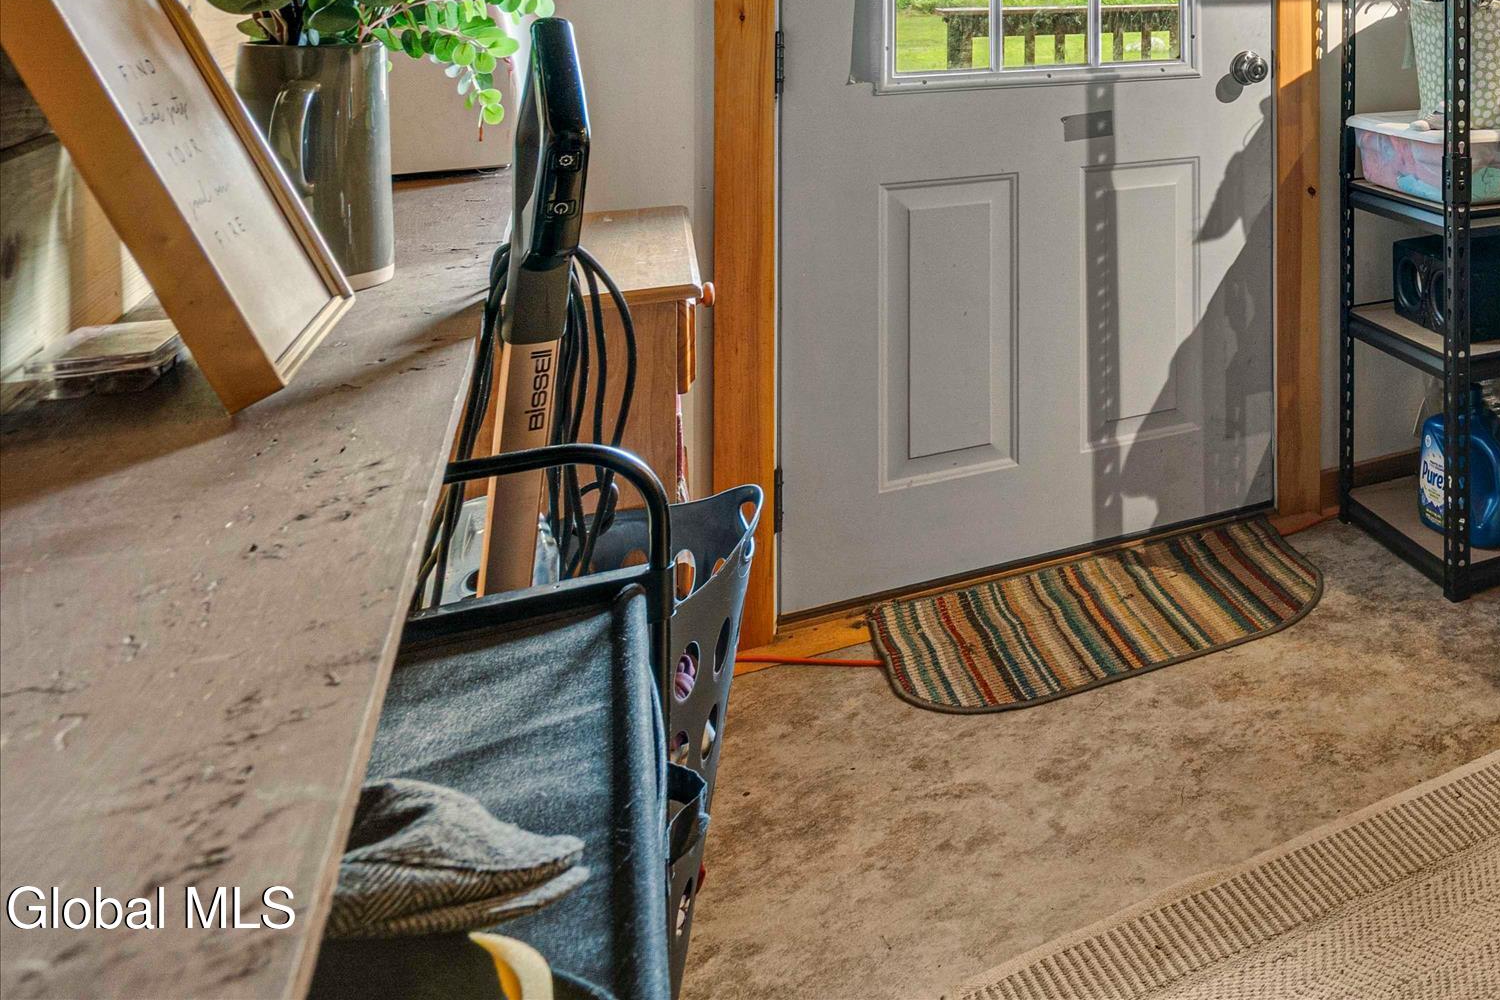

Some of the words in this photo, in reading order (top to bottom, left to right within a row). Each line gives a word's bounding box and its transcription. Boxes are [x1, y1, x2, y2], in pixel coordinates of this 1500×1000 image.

[214, 216, 246, 249] FIRE
[524, 350, 553, 432] BISSELL
[1421, 459, 1445, 490] Pure
